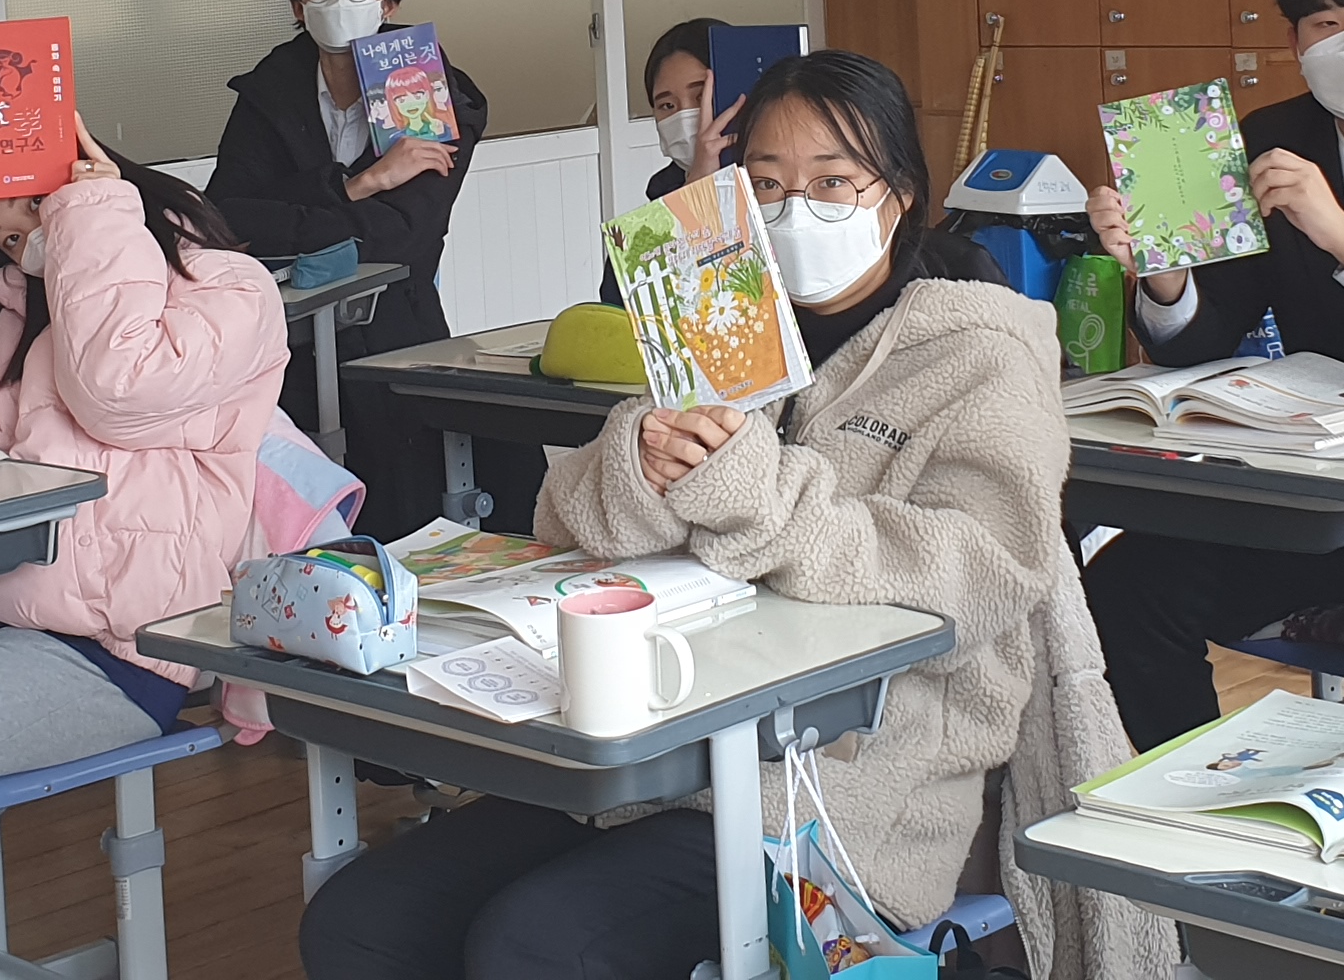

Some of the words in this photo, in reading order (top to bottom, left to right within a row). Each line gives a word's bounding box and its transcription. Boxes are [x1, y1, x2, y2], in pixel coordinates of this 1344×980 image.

[361, 36, 414, 59] 나에게만
[378, 52, 418, 71] 보이는
[419, 42, 438, 65] 것
[847, 415, 912, 446] COLORAD
